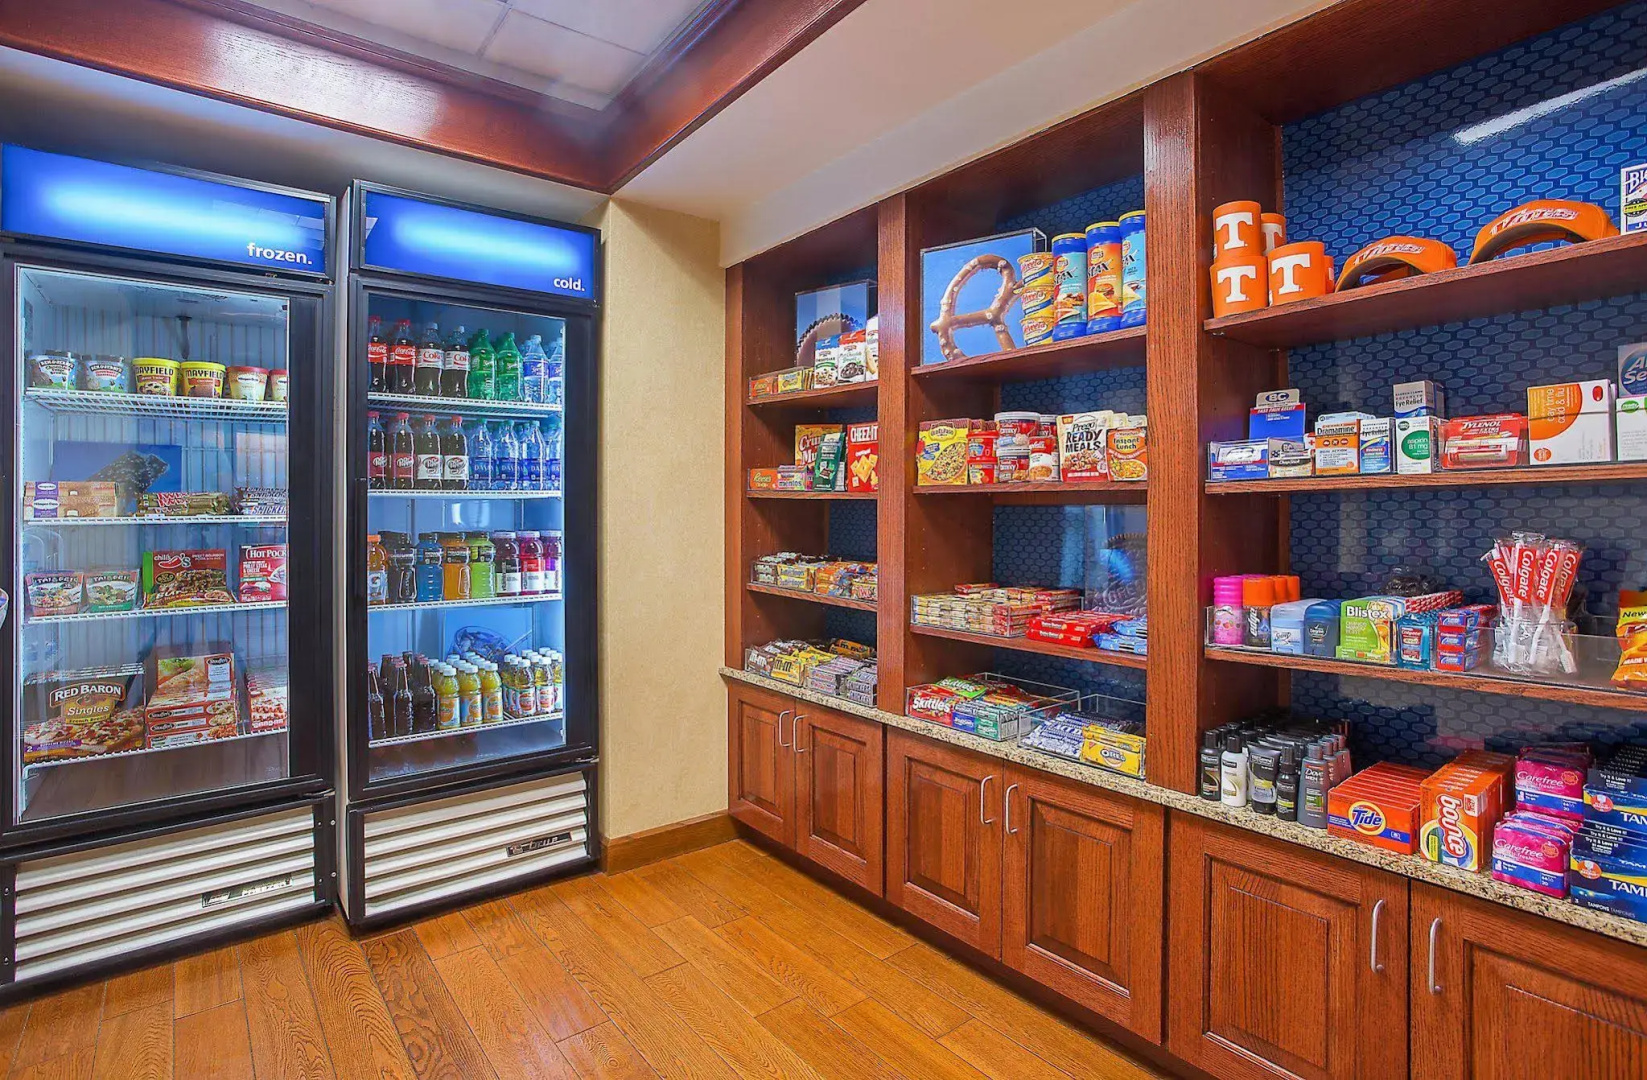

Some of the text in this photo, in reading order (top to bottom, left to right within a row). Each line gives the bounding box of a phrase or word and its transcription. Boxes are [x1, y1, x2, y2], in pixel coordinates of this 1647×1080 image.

[1216, 212, 1252, 250] T
[246, 242, 313, 265] frozen.
[1271, 253, 1311, 294] T
[554, 276, 586, 292] cold.
[1217, 265, 1256, 304] T
[1268, 393, 1288, 402] BC
[1406, 398, 1422, 406] Relief
[1072, 422, 1096, 432] Prego
[1317, 426, 1354, 435] Dramamine
[1464, 420, 1501, 430] TYLENOL
[800, 434, 821, 451] Crun
[1066, 428, 1102, 444] READY
[1066, 440, 1100, 454] MEALS
[1418, 443, 1428, 451] mg
[250, 550, 266, 558] HOT
[1518, 550, 1534, 598] Colgate
[1536, 548, 1558, 598] Colgate
[1560, 552, 1578, 592] Colgat
[1493, 560, 1514, 606] Colgate
[1346, 606, 1388, 620] Blistex
[1248, 607, 1260, 636] edge
[54, 684, 122, 702] RED BARON
[940, 679, 976, 692] Skittles
[67, 704, 110, 716] Singles
[912, 697, 951, 713] Skittles
[1100, 749, 1126, 762] OREO
[1306, 768, 1324, 776] Dove
[1516, 770, 1564, 786] Carefree
[1352, 808, 1383, 826] Tide
[1440, 795, 1466, 857] bounce
[1494, 838, 1544, 857] Carefree
[1587, 902, 1610, 912] TAMPONS
